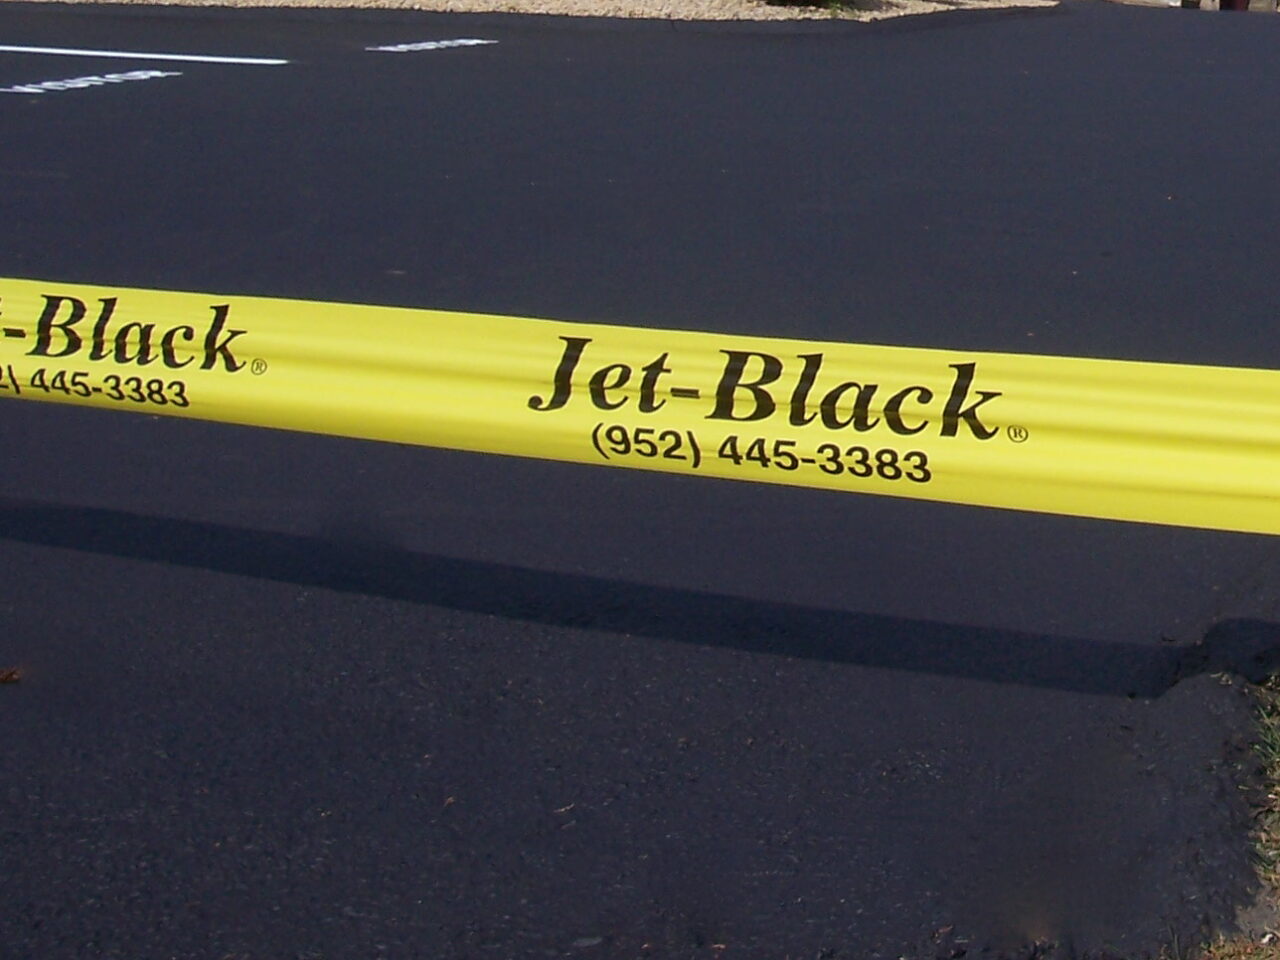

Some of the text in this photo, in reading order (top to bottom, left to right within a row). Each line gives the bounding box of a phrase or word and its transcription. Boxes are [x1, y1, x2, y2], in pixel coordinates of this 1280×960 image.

[30, 368, 190, 407] 445-3383
[591, 422, 932, 483] (952) 445-3383
